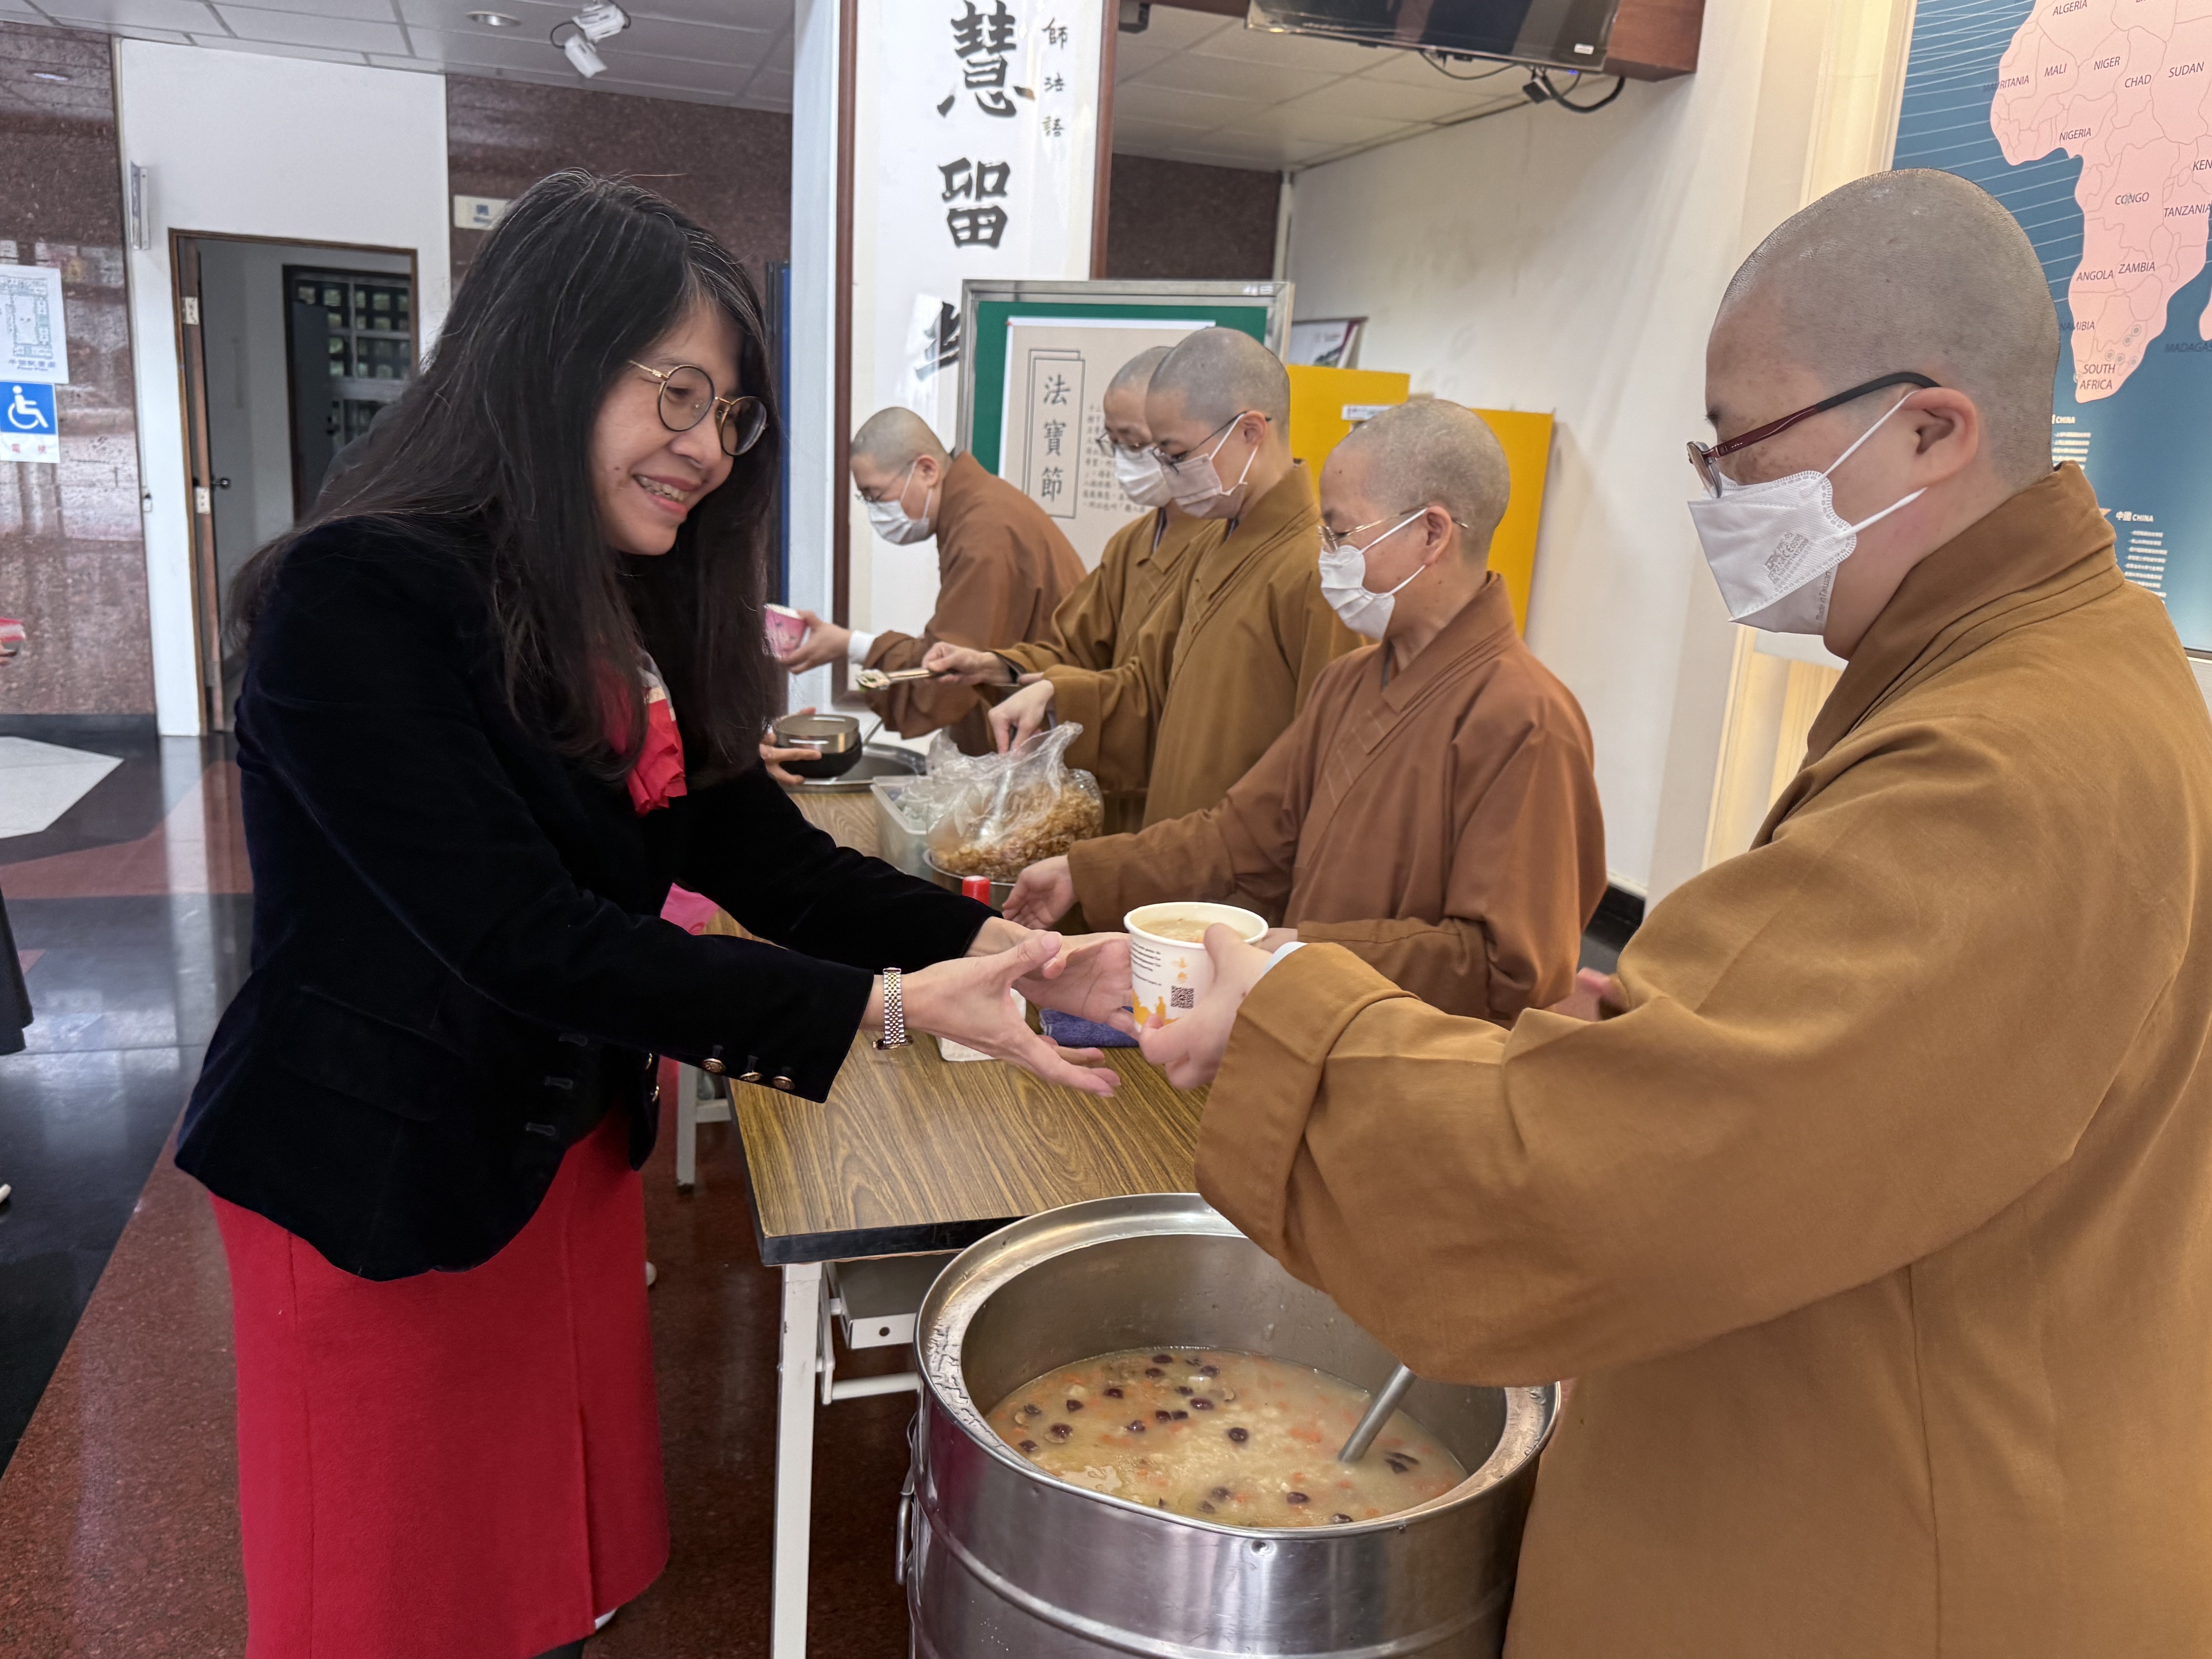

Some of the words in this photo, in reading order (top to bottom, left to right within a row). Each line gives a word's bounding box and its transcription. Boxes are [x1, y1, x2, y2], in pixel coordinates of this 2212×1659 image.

[2052, 0, 2087, 16] ALGERIA
[2044, 64, 2067, 77] MALI
[2094, 57, 2120, 70] NIGER
[2168, 61, 2204, 78] SUDAN
[2124, 74, 2152, 88] CHAD
[2059, 127, 2091, 141] NIGERIA
[2115, 192, 2149, 205] CONGO
[2164, 203, 2212, 218] TANZANIA
[2076, 270, 2114, 282] ANGOLA
[2118, 261, 2155, 274] ZAMBIA
[2083, 364, 2116, 374] SOUTH
[2080, 379, 2112, 390] AFRICA
[1041, 372, 1072, 502] 法寶節
